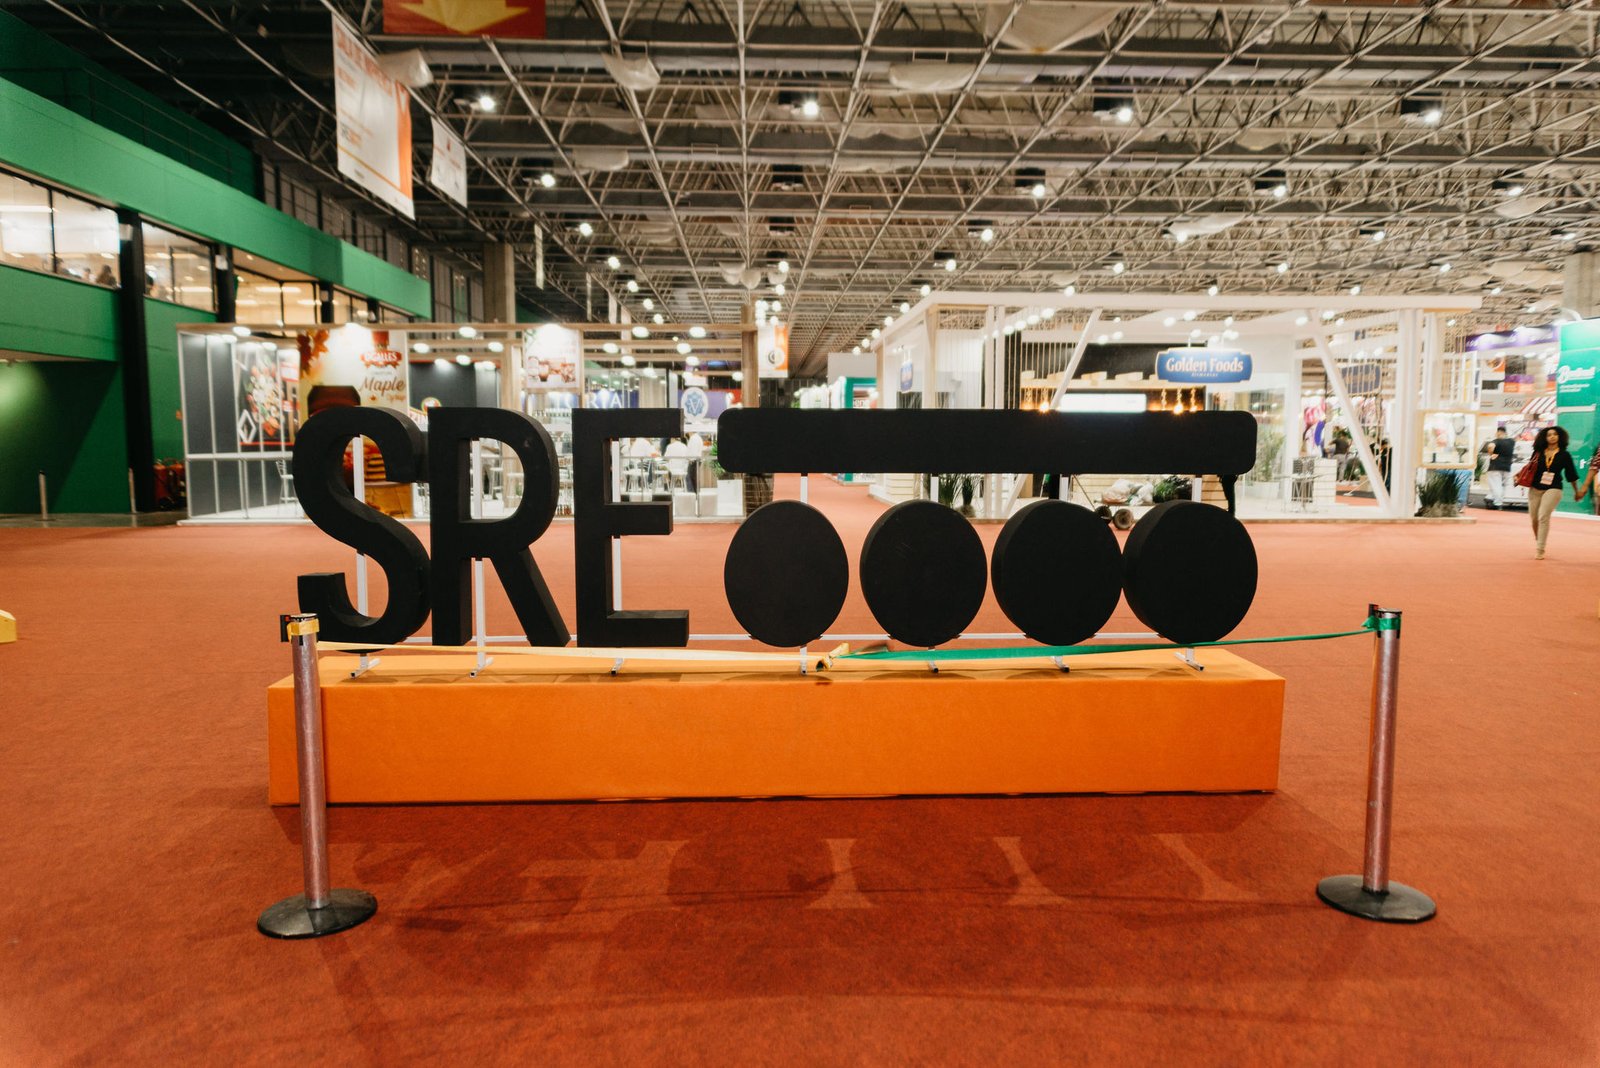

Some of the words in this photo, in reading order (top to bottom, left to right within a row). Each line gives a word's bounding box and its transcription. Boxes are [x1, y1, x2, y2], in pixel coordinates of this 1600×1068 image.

[1166, 357, 1208, 372] Golden
[1209, 356, 1244, 372] Foods
[359, 376, 406, 396] Maple
[292, 406, 690, 653] SRE
